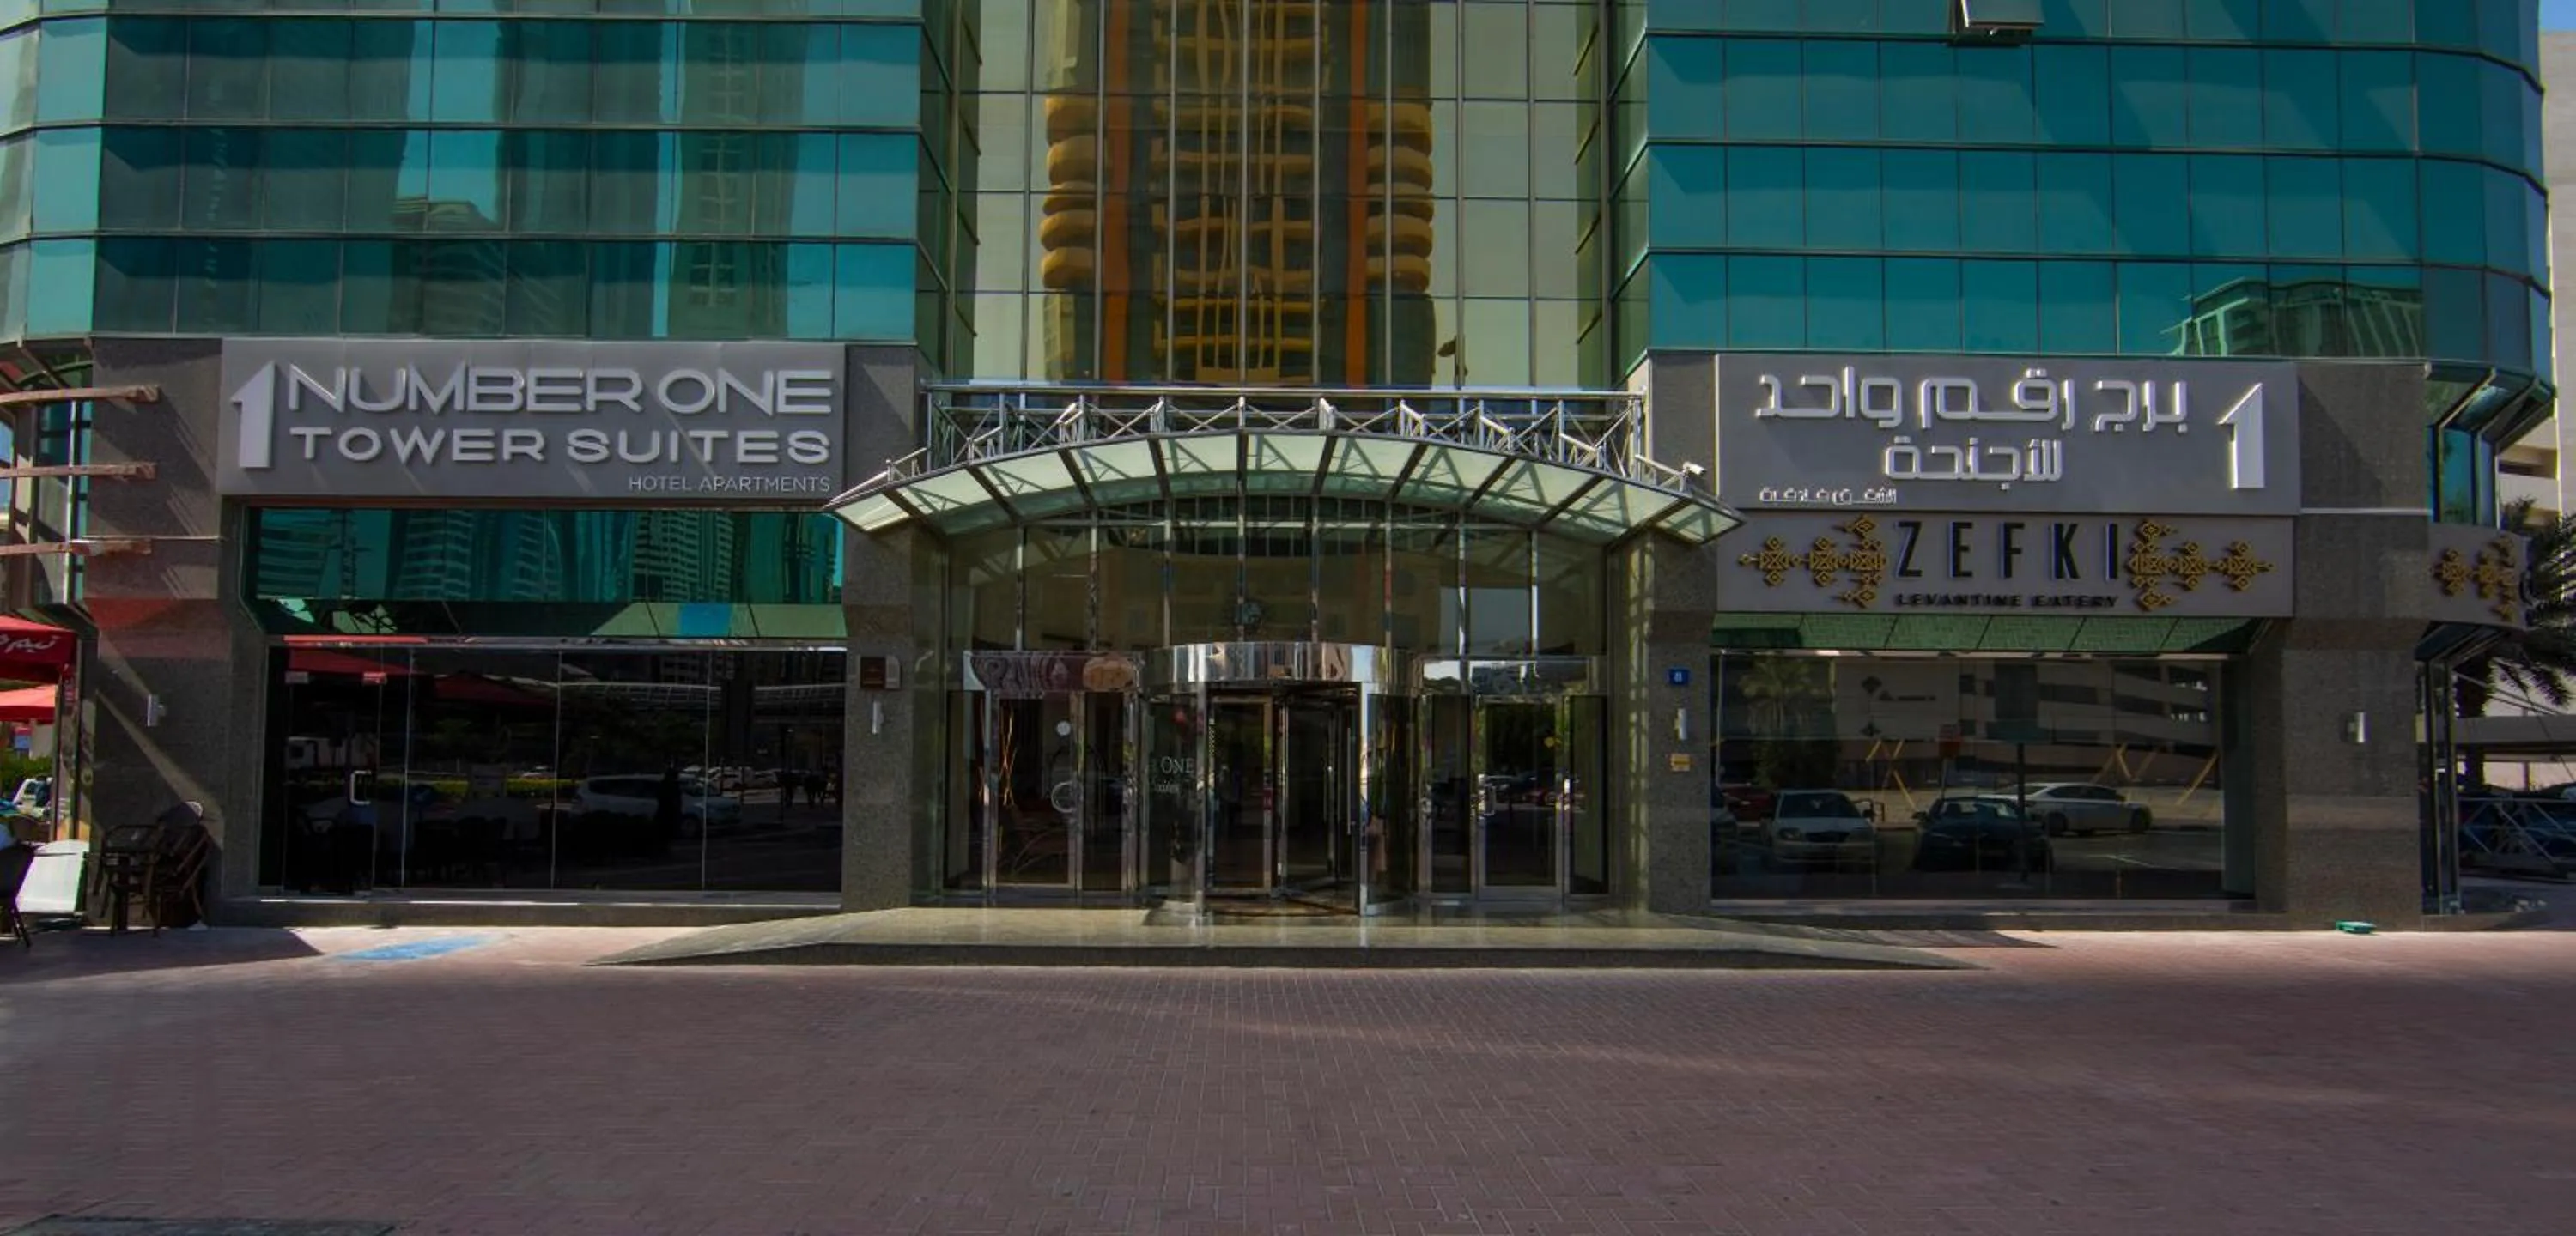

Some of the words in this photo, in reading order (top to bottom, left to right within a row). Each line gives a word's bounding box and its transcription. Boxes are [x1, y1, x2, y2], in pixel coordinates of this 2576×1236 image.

[288, 360, 642, 415] NUMBER
[657, 367, 832, 416] ONE
[1754, 366, 1903, 428] واحد
[1915, 367, 2076, 431] رقم
[2094, 379, 2187, 433] برج
[289, 426, 545, 464] TOWER
[567, 428, 831, 464] SUITES
[1884, 435, 2063, 490] للأجنحة
[628, 476, 691, 494] HOTEL
[698, 476, 830, 494] APARTMENTS
[1894, 521, 2120, 581] ZEFKI
[1893, 593, 2023, 608] LEVANTINE
[2030, 594, 2119, 609] EATERY
[1161, 756, 1195, 774] ONE
